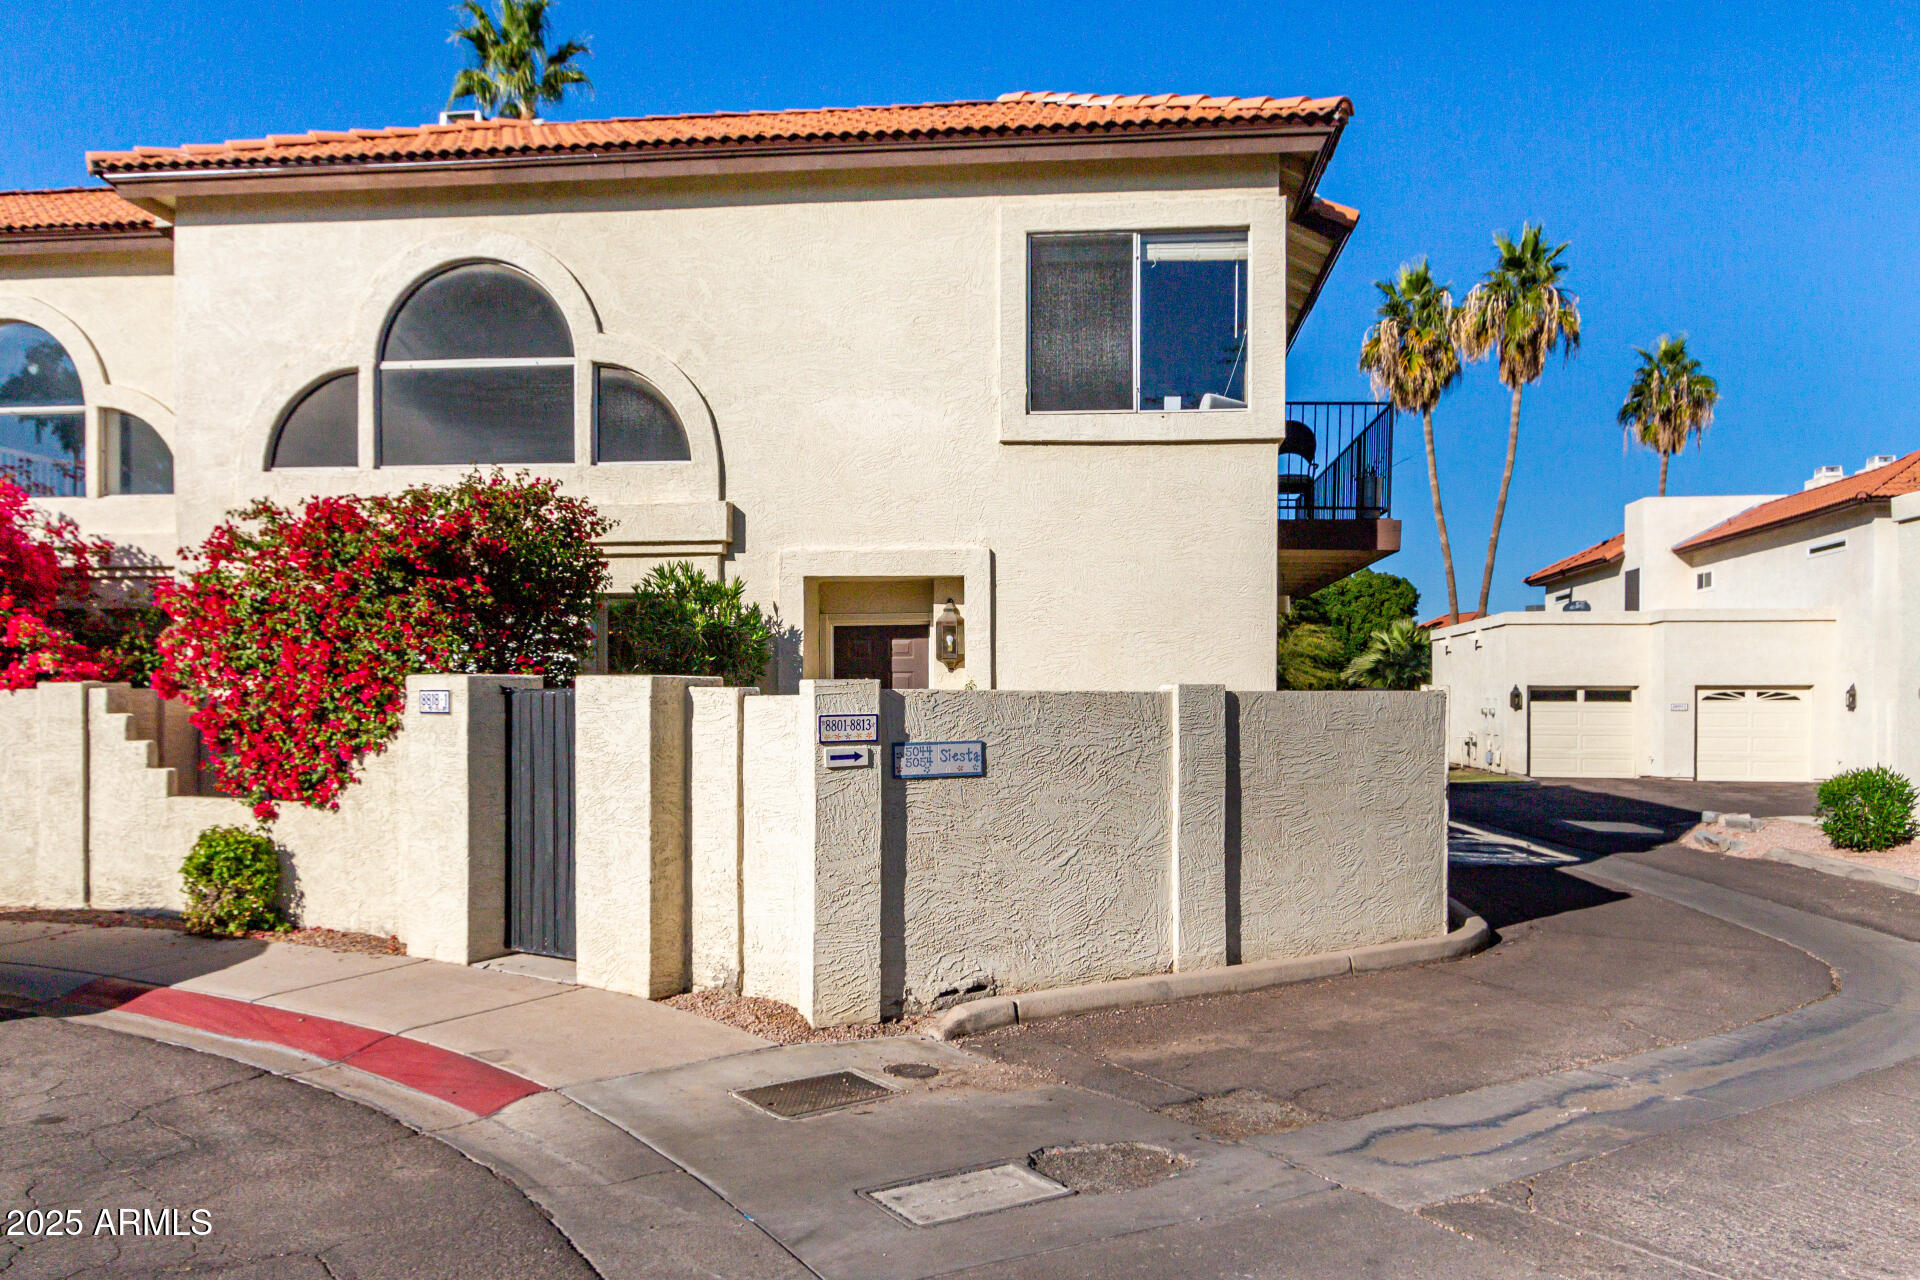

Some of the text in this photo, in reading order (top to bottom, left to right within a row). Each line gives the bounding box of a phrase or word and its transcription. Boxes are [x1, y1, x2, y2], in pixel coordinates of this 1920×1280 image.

[825, 718, 872, 732] 8801-8813
[905, 745, 933, 757] 5044
[940, 747, 981, 763] Siesta
[905, 757, 933, 768] 5054
